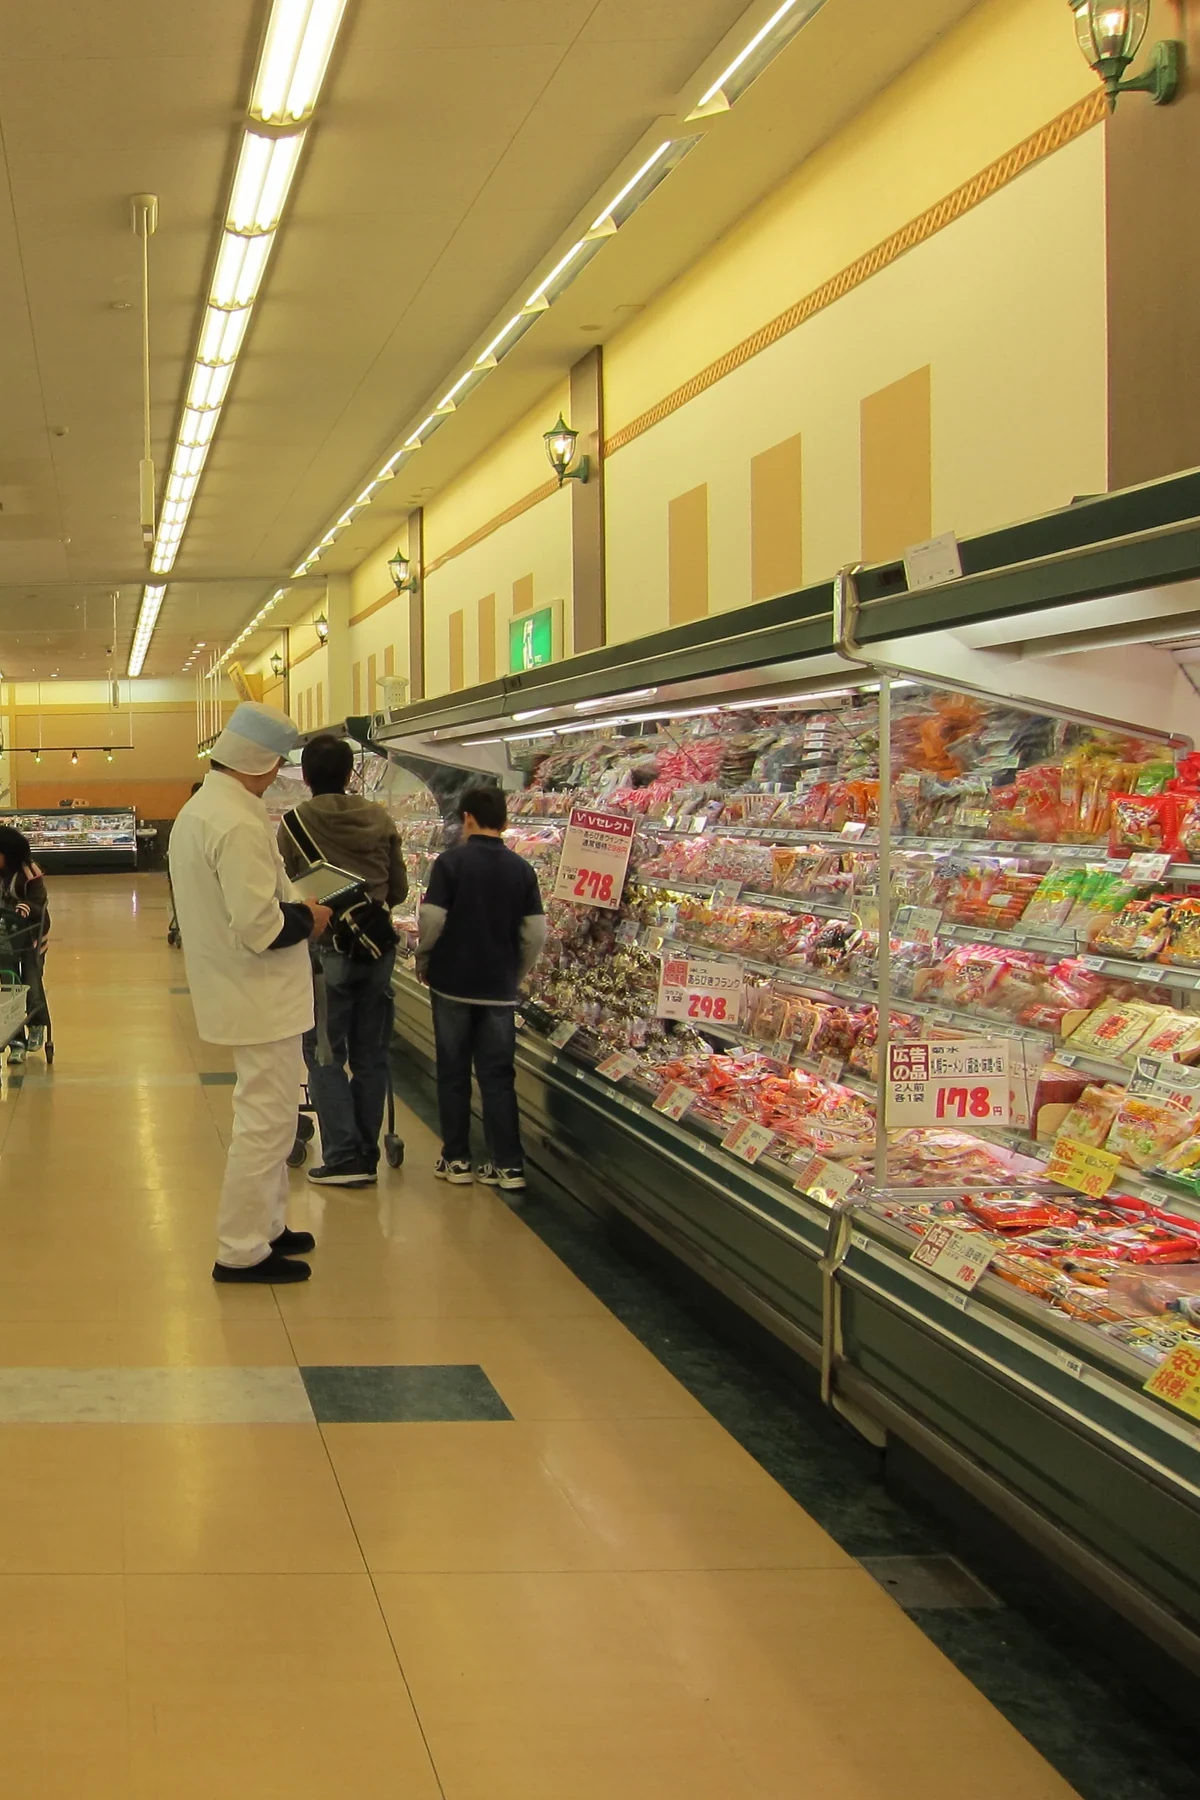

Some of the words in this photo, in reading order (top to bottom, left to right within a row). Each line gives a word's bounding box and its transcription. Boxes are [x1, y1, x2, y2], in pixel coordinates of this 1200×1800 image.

[588, 816, 630, 832] Vセレクト
[574, 869, 613, 901] 278
[688, 994, 726, 1020] 298
[893, 1047, 927, 1063] 広告
[893, 1064, 927, 1080] の品
[894, 1083, 924, 1092] 2人前
[936, 1087, 990, 1118] 178
